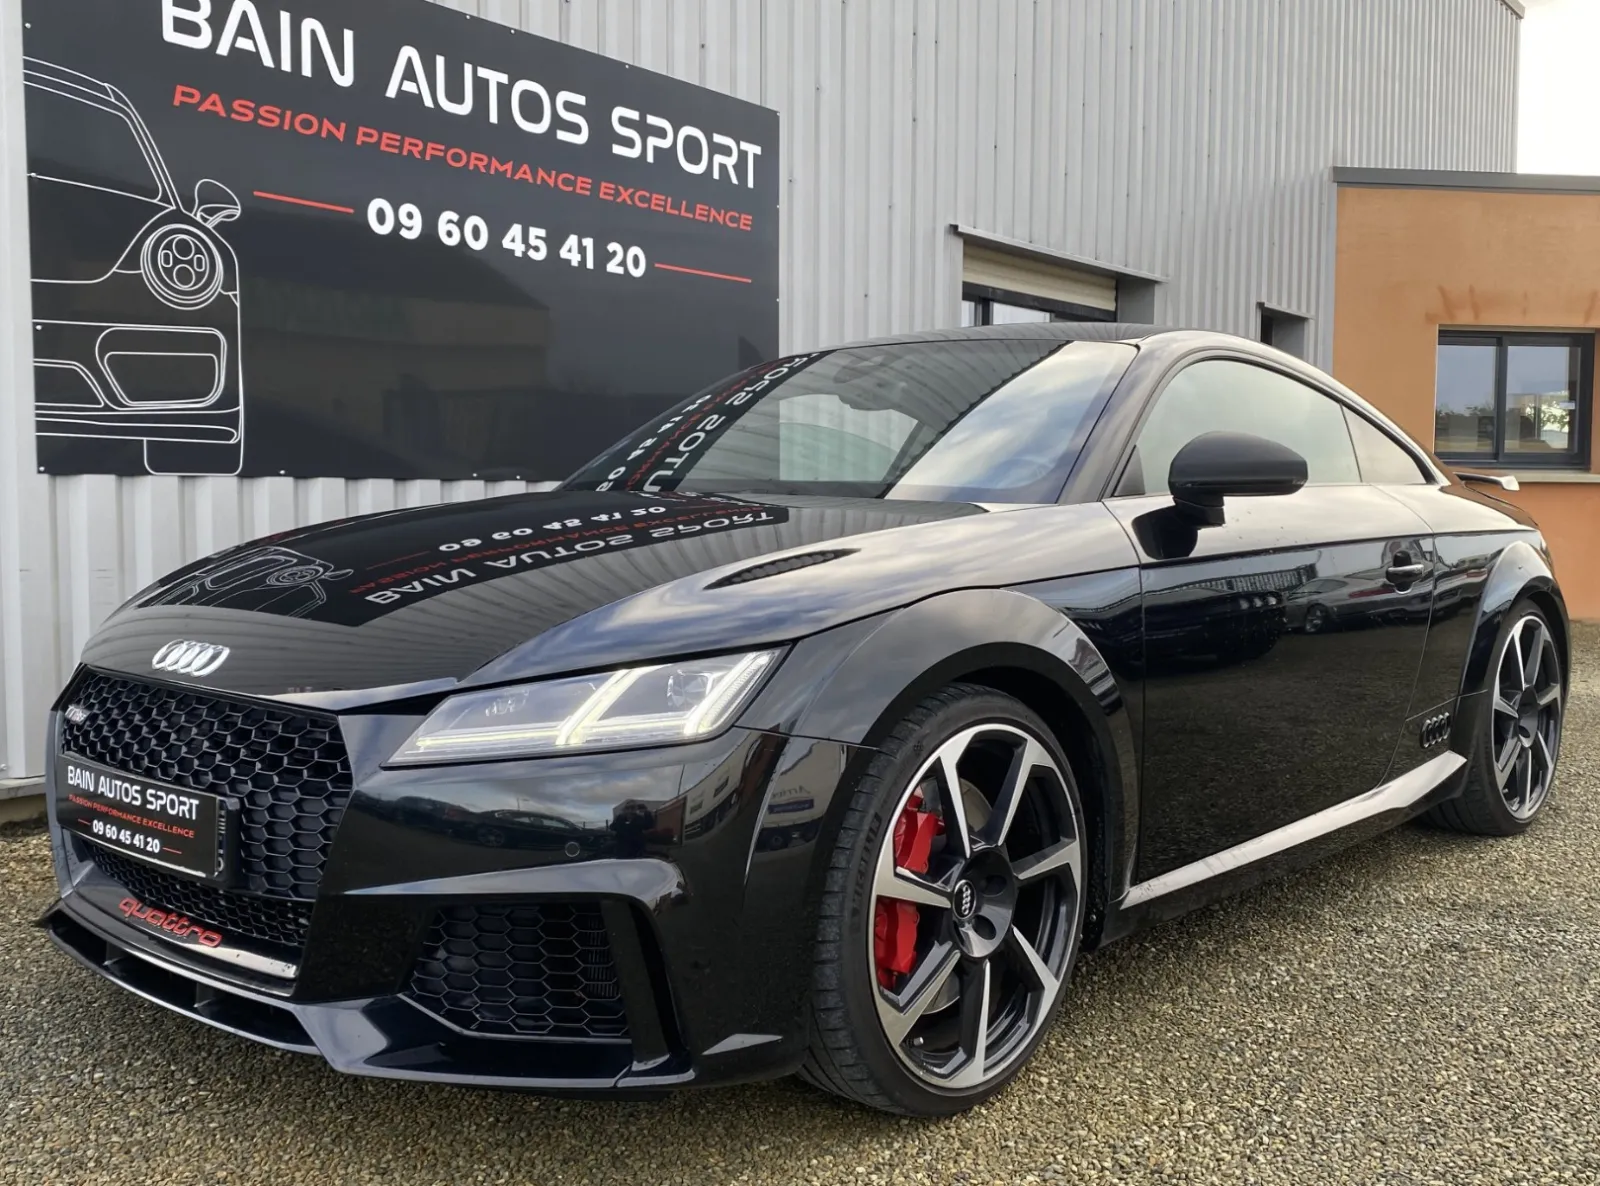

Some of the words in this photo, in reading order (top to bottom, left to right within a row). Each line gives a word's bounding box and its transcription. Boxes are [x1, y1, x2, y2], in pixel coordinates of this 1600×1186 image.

[161, 0, 354, 87] BAIN
[385, 45, 589, 145] AUTOS
[611, 106, 762, 189] SPORT
[173, 85, 346, 142] PASSION
[356, 126, 592, 196] PERFORMANCE
[599, 181, 753, 231] EXCELLENCE
[367, 198, 423, 240] 09
[437, 210, 488, 251] 60
[501, 223, 547, 261] 45
[559, 234, 594, 270] 41
[606, 242, 646, 278] 20
[67, 765, 94, 793] BAIN
[98, 775, 141, 806] AUTOS
[146, 789, 199, 820] SPORT
[68, 793, 93, 811] PASSION
[93, 803, 141, 825] PERFORMANCE
[142, 815, 195, 838] EXCELLENCE
[92, 819, 104, 834] 09
[105, 825, 117, 840] 60
[119, 830, 131, 845] 45
[133, 834, 144, 849] 41
[146, 838, 160, 853] 20
[118, 898, 222, 948] quattro
